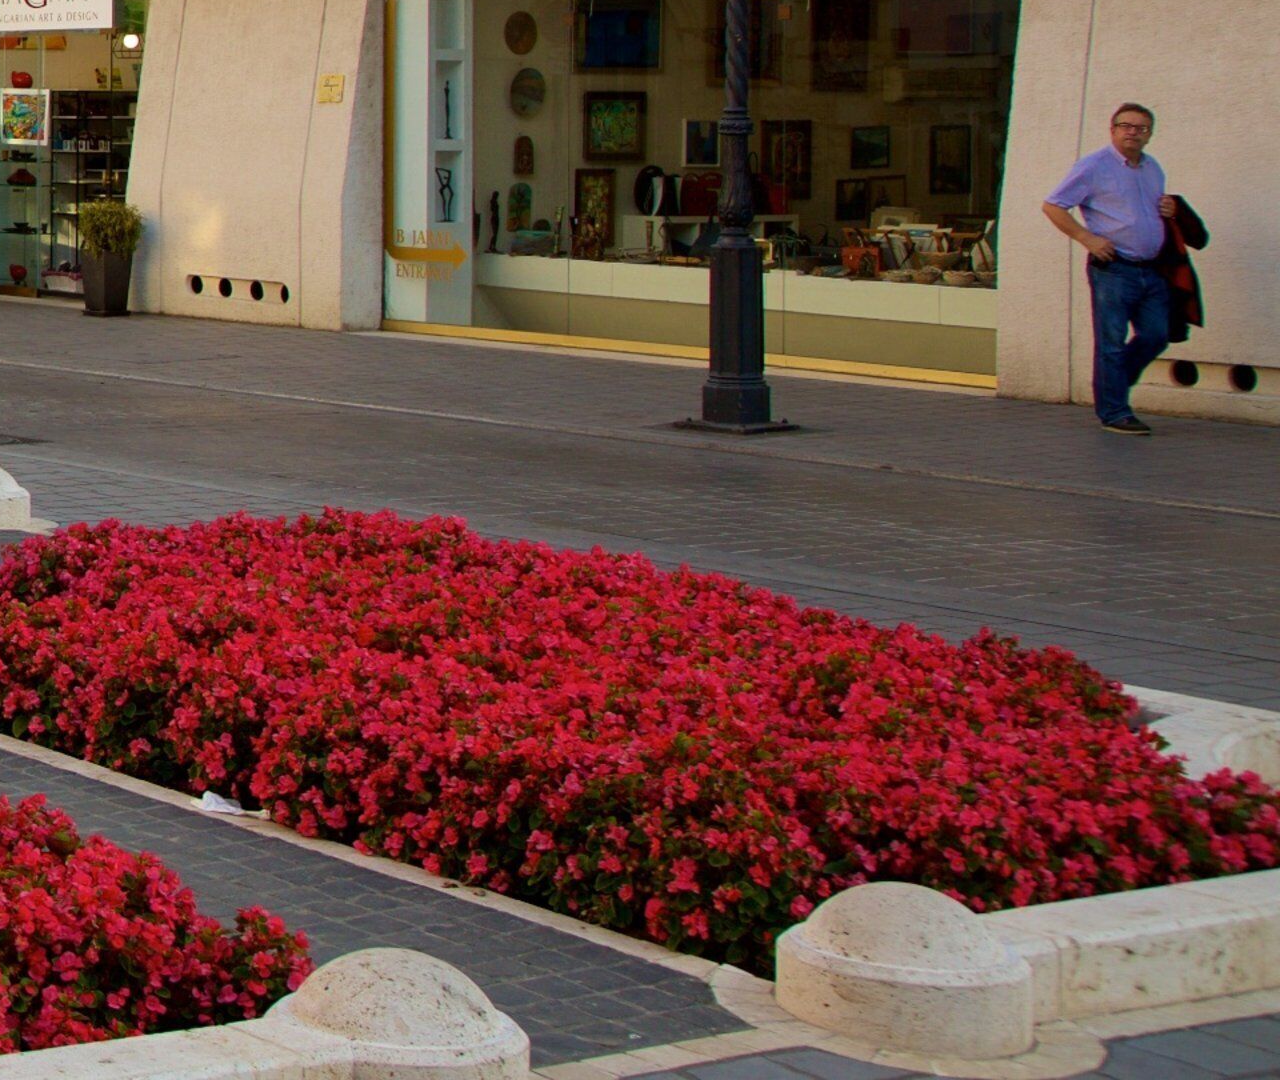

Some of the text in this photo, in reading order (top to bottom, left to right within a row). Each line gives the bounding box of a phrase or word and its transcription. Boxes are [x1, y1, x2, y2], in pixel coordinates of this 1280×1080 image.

[39, 12, 53, 22] ART
[57, 13, 63, 22] &
[66, 10, 99, 21] DESIGN
